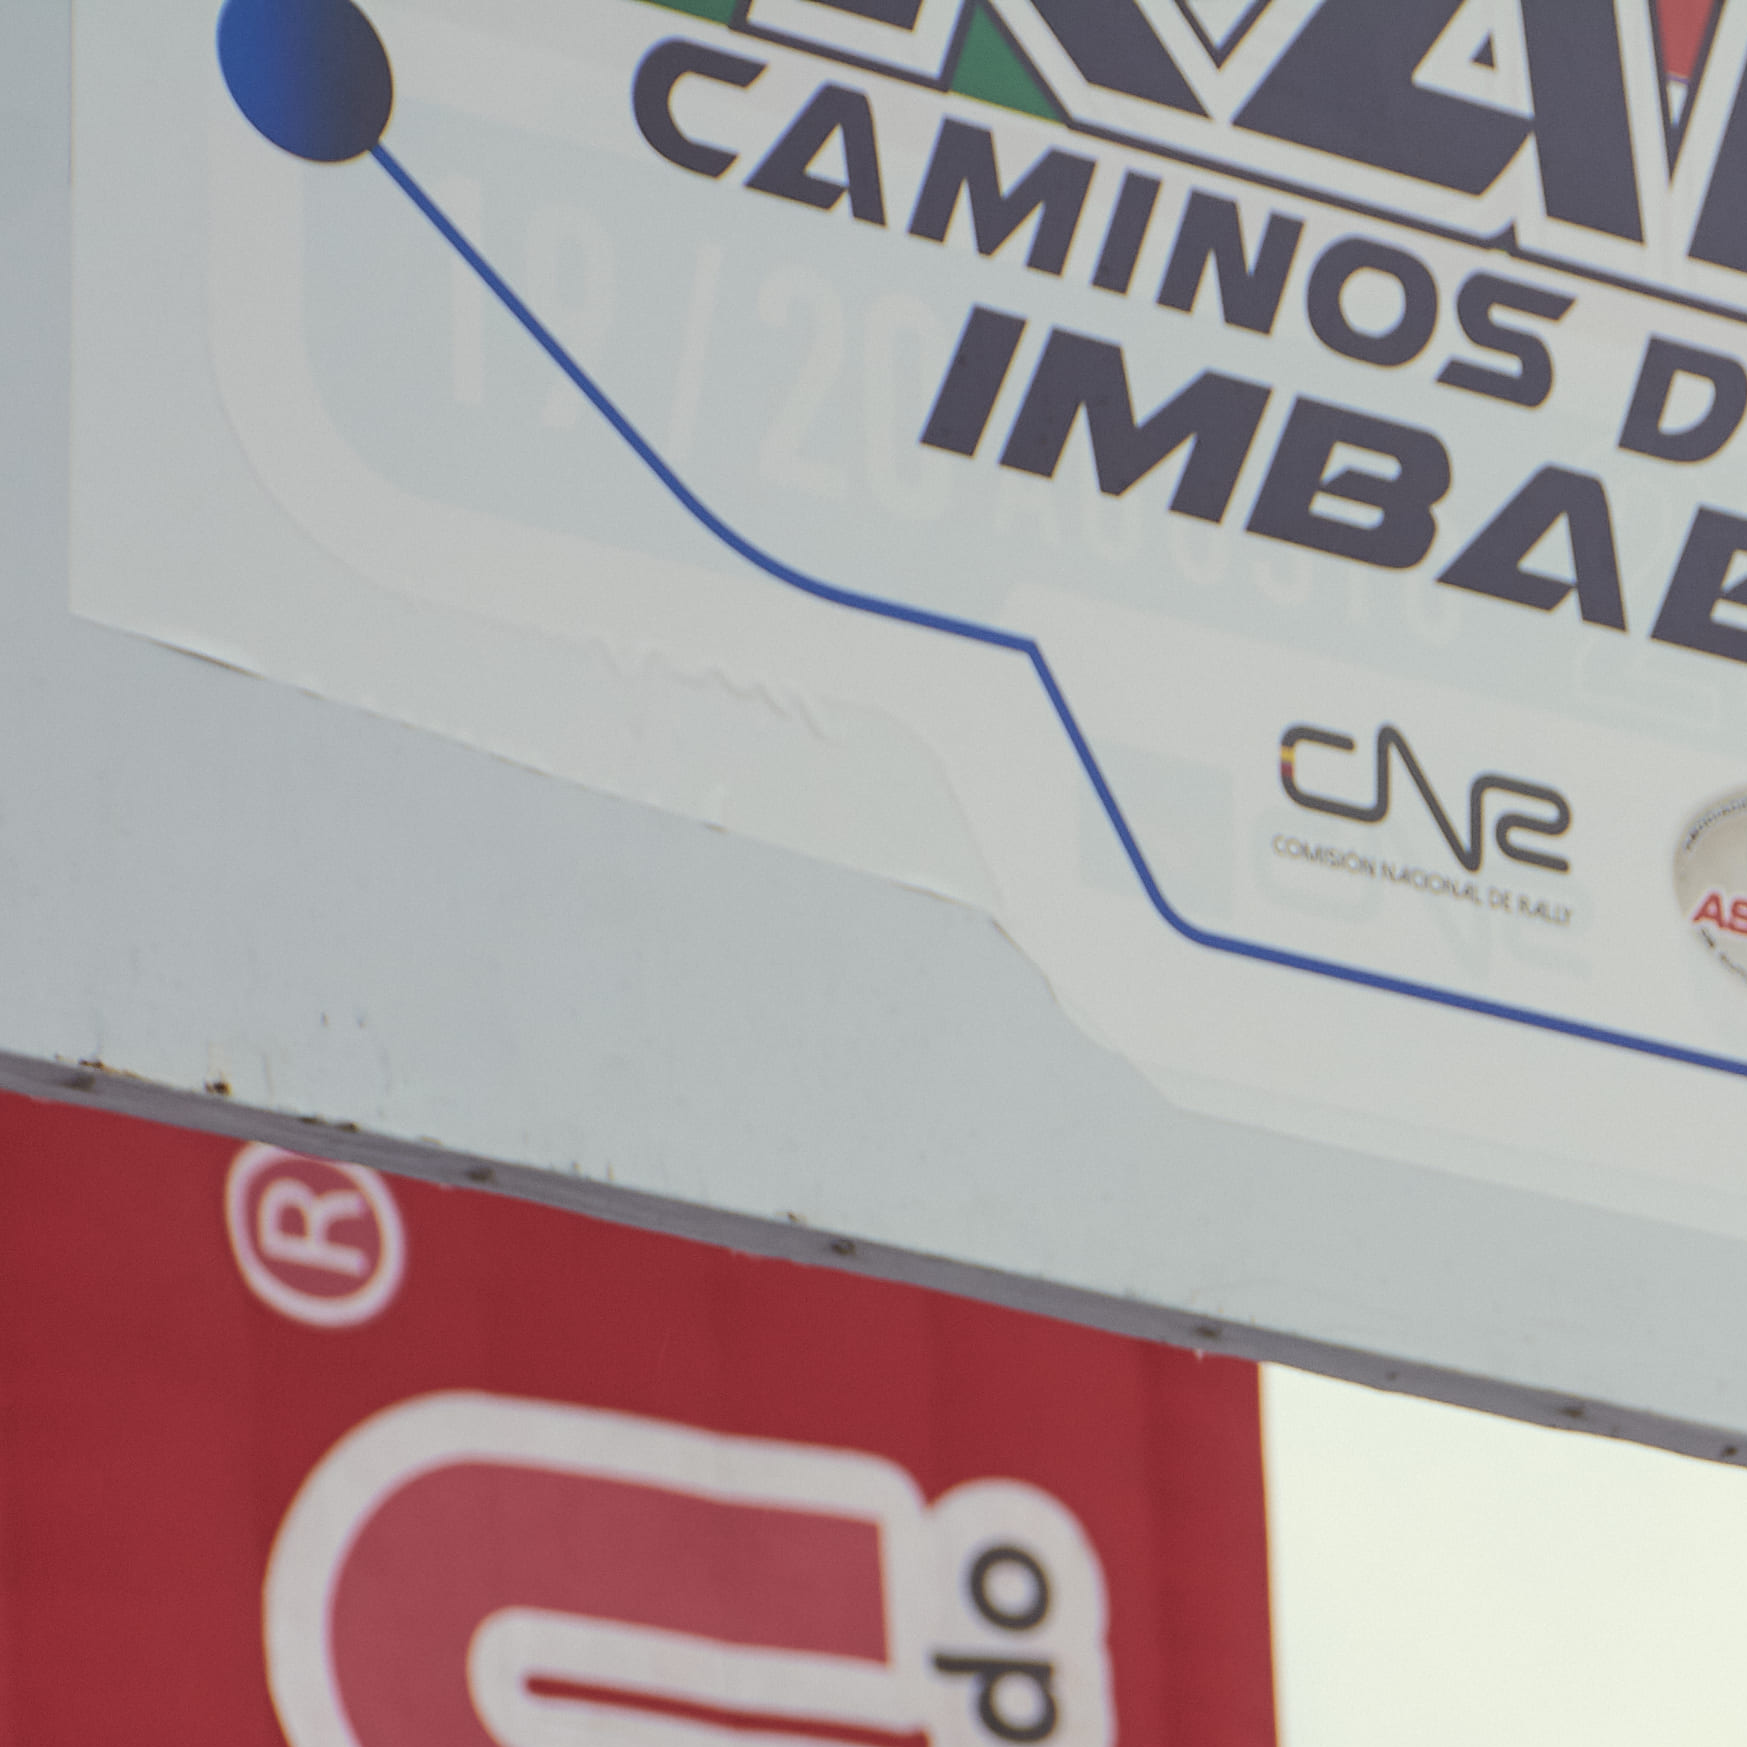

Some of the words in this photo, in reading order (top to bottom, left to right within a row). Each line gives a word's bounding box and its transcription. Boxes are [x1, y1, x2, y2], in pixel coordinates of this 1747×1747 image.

[632, 37, 1576, 408] CAMINOS
[1381, 859, 1481, 906] NACIONAL
[1488, 887, 1512, 912] DE
[1518, 891, 1573, 927] RALLY
